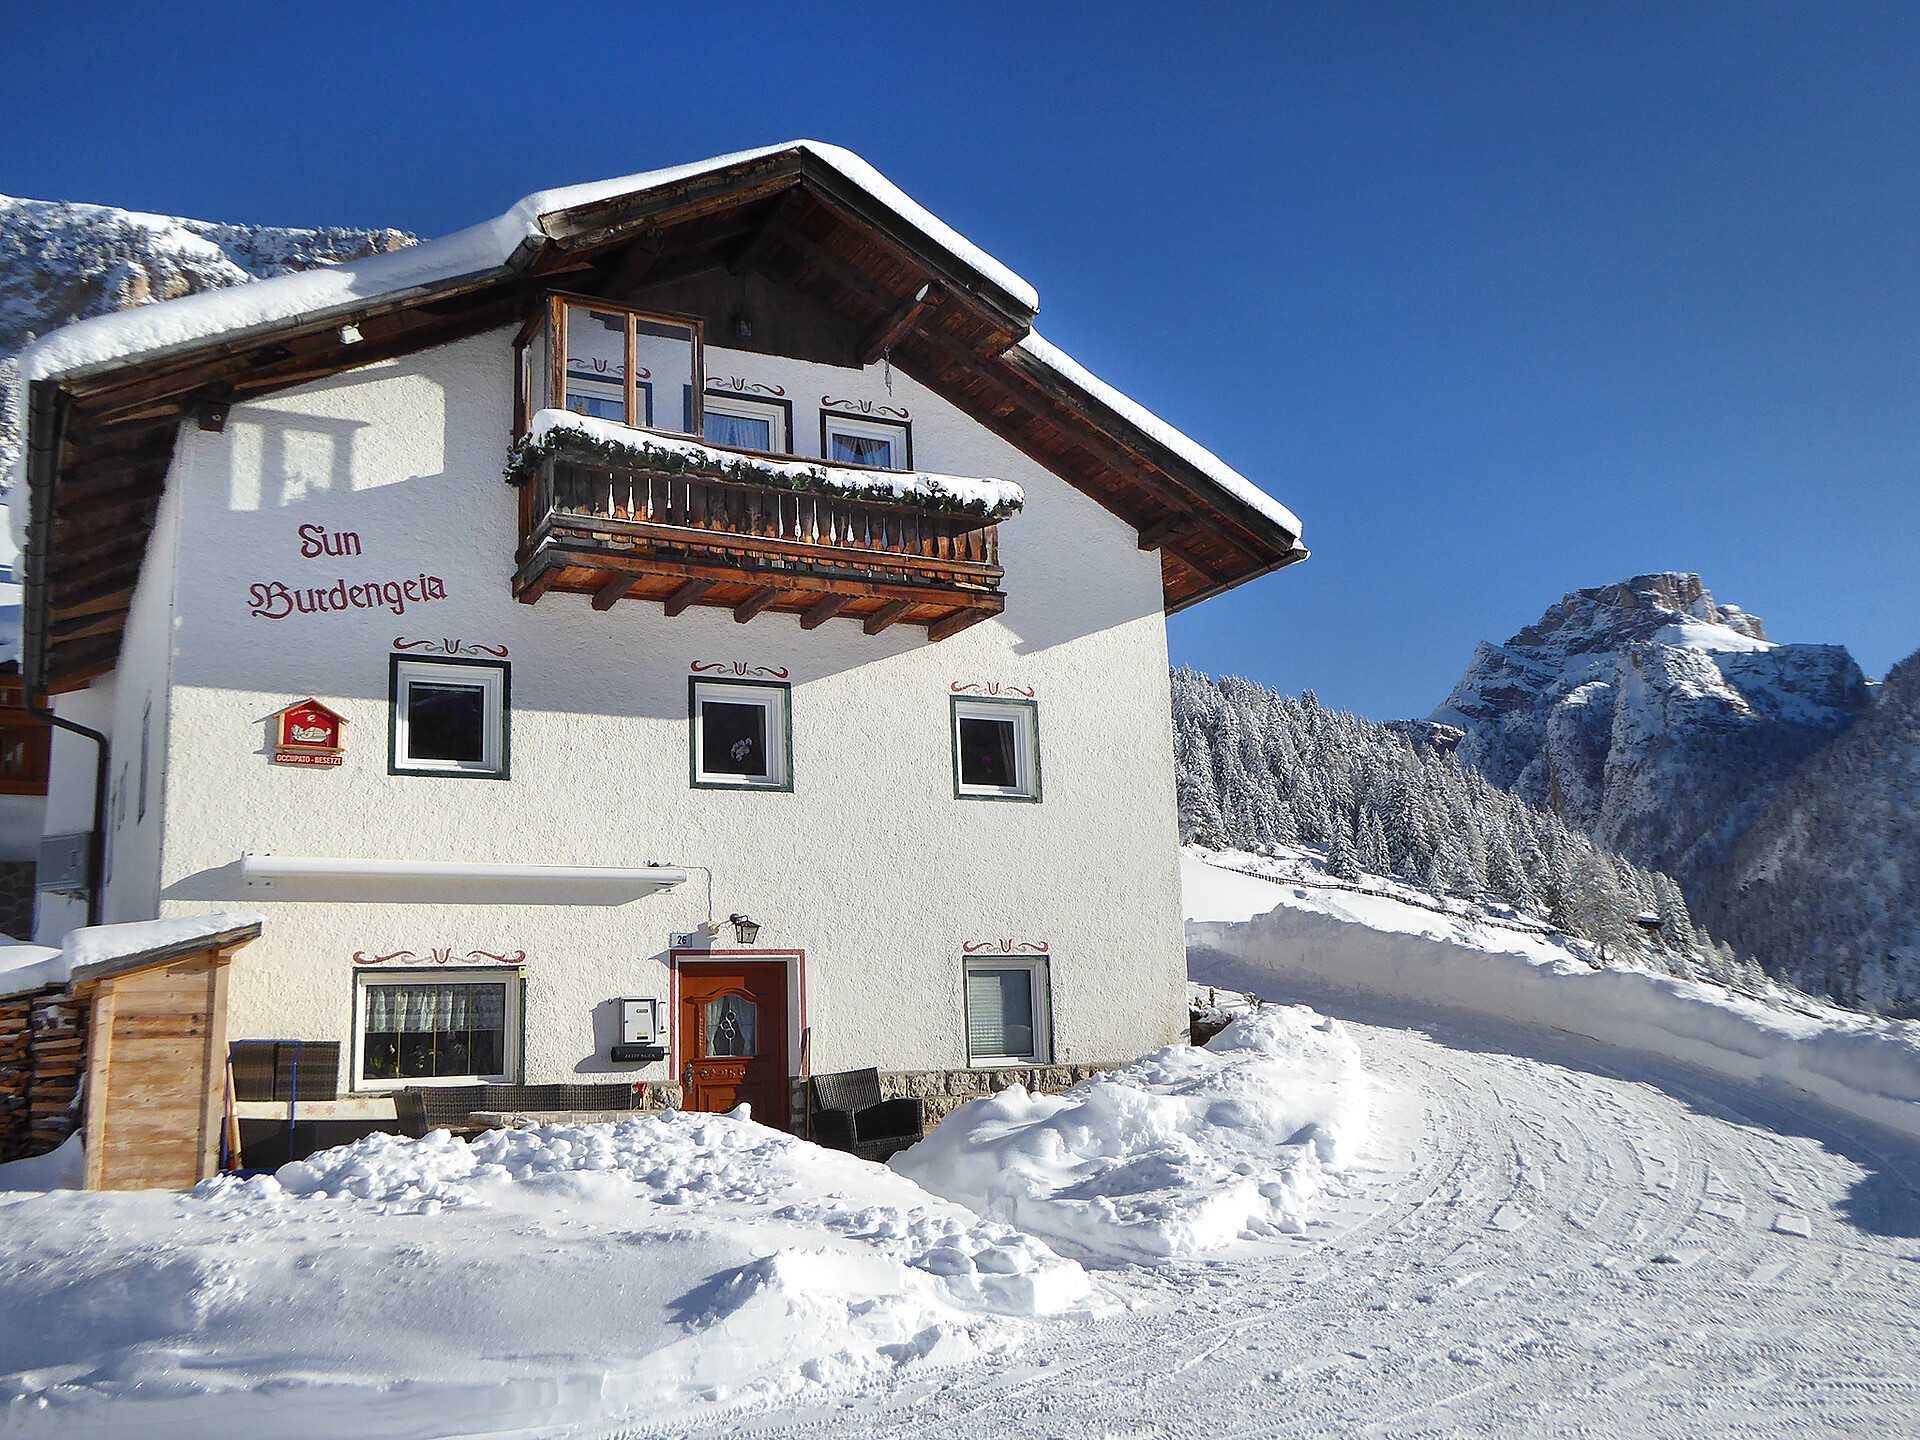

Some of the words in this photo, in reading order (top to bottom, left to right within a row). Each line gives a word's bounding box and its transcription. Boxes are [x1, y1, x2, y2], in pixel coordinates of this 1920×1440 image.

[298, 524, 362, 558] Sun
[247, 573, 448, 619] Burdengeia
[276, 754, 311, 763] OCCUPATO
[314, 756, 342, 765] BESETZT
[677, 935, 687, 945] 26
